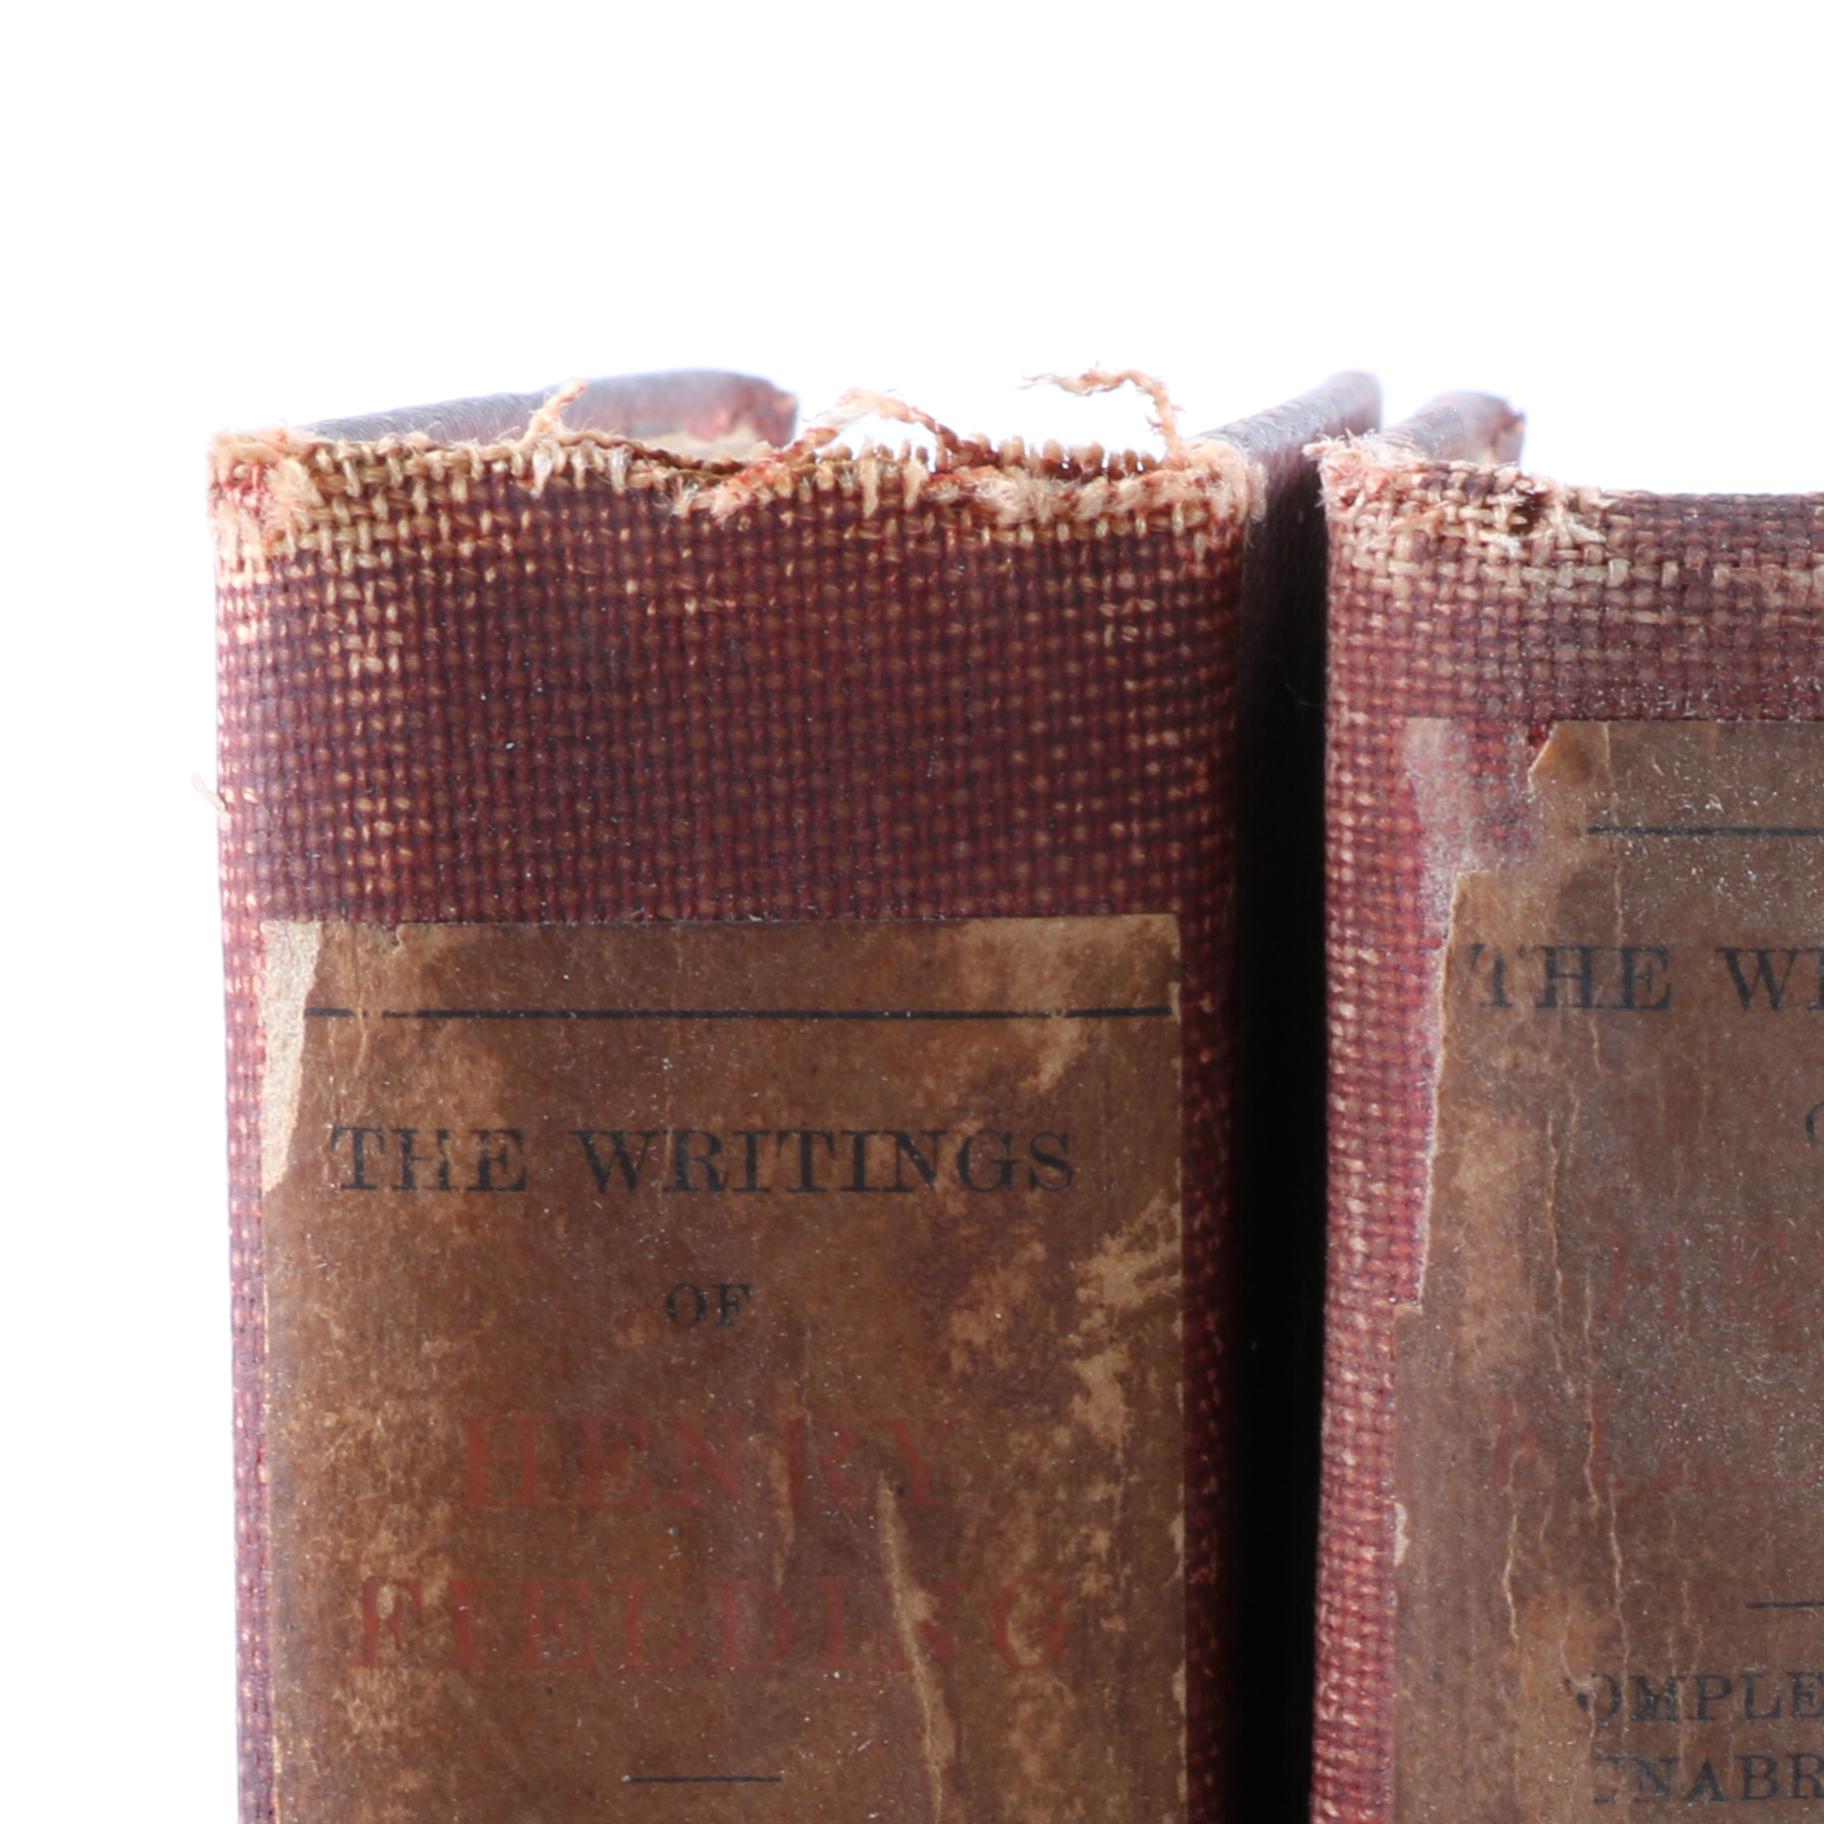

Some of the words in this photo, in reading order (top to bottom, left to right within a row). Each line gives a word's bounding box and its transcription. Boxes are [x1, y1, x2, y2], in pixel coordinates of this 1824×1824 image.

[331, 1126, 527, 1192] THE
[568, 1127, 1077, 1193] WRITINGS
[665, 1282, 753, 1328] OF
